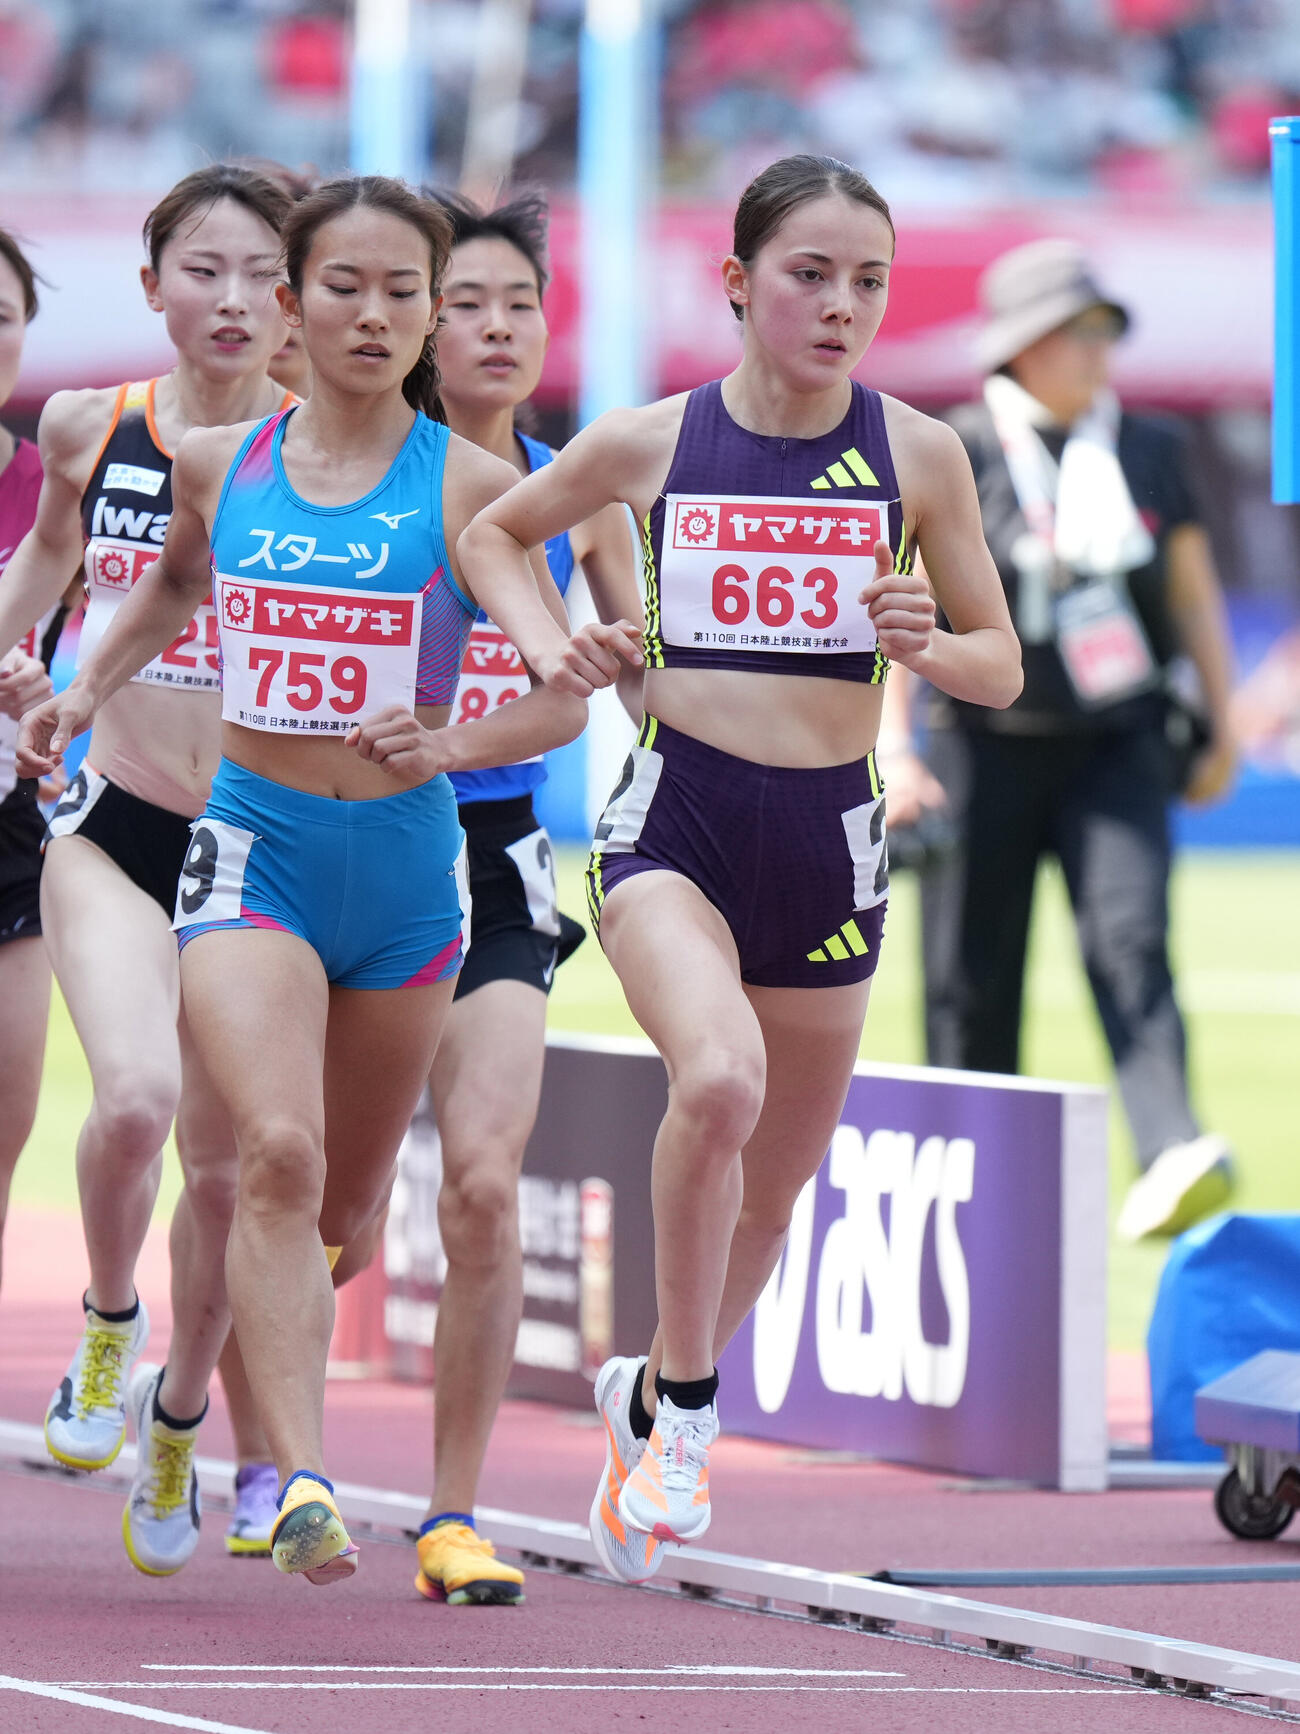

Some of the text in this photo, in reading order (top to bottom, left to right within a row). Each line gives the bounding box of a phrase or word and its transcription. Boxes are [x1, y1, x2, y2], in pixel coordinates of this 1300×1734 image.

[728, 513, 871, 546] ヤマザキ
[238, 528, 389, 579] スターツ
[263, 598, 403, 636] ヤマザキ
[711, 563, 839, 629] 663
[693, 631, 849, 648] 第110回 日本陸上競技選手権大会
[248, 646, 368, 715] 759
[239, 710, 267, 726] 第110回
[180, 826, 219, 916] 9
